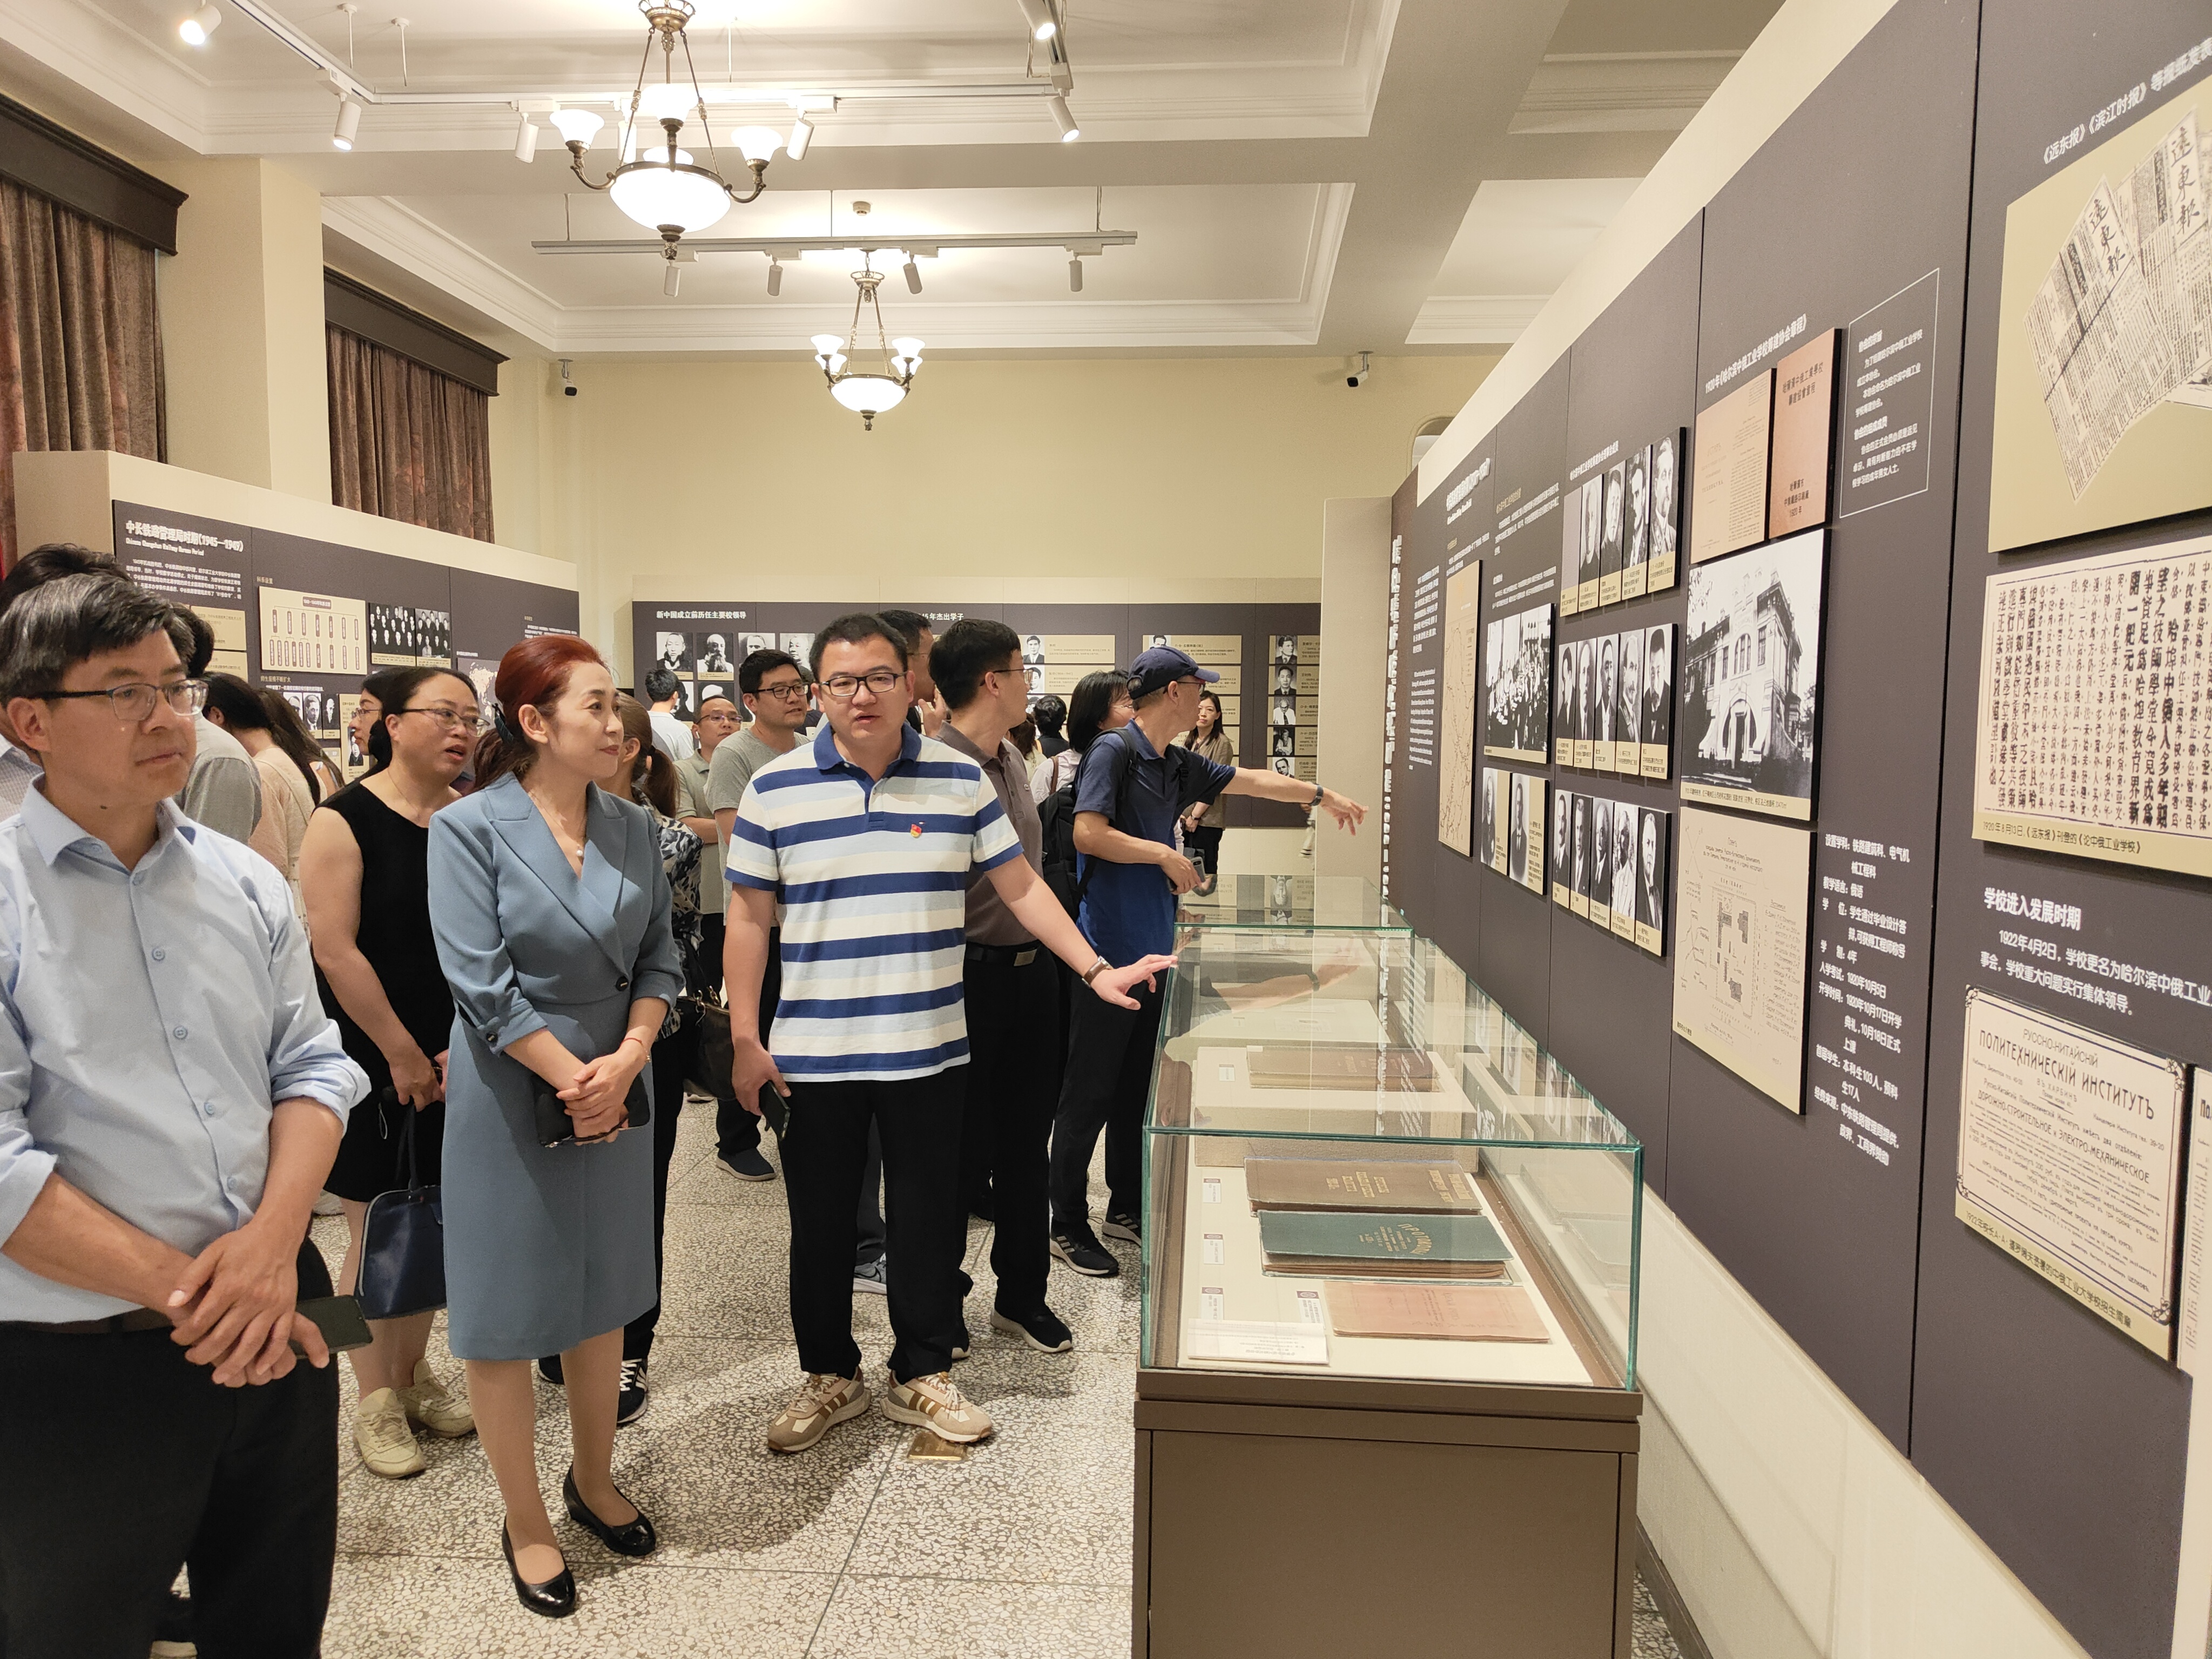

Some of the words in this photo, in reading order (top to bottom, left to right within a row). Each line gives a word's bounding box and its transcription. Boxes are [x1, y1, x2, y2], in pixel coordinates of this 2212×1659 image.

[656, 611, 747, 619] 新中国成立前历任主要校领导
[1984, 887, 2082, 930] 学校进入发展时期
[1980, 951, 2133, 1015] 事会，学校重大问题实行集体领导。
[1999, 929, 2212, 1008] 1922年4月2日，学校更名为哈尔滨中俄工业
[1843, 1037, 1857, 1054] 上课
[1842, 1081, 1860, 1102] 生17人
[1979, 1029, 2076, 1087] ПОЛИТЕХНИЧЕСКІЙ
[2081, 1071, 2155, 1121] ИНСТИТУТЪ
[2200, 1097, 2212, 1120] ПО
[1398, 1222, 1434, 1255] ПРОТОКОЛЫ
